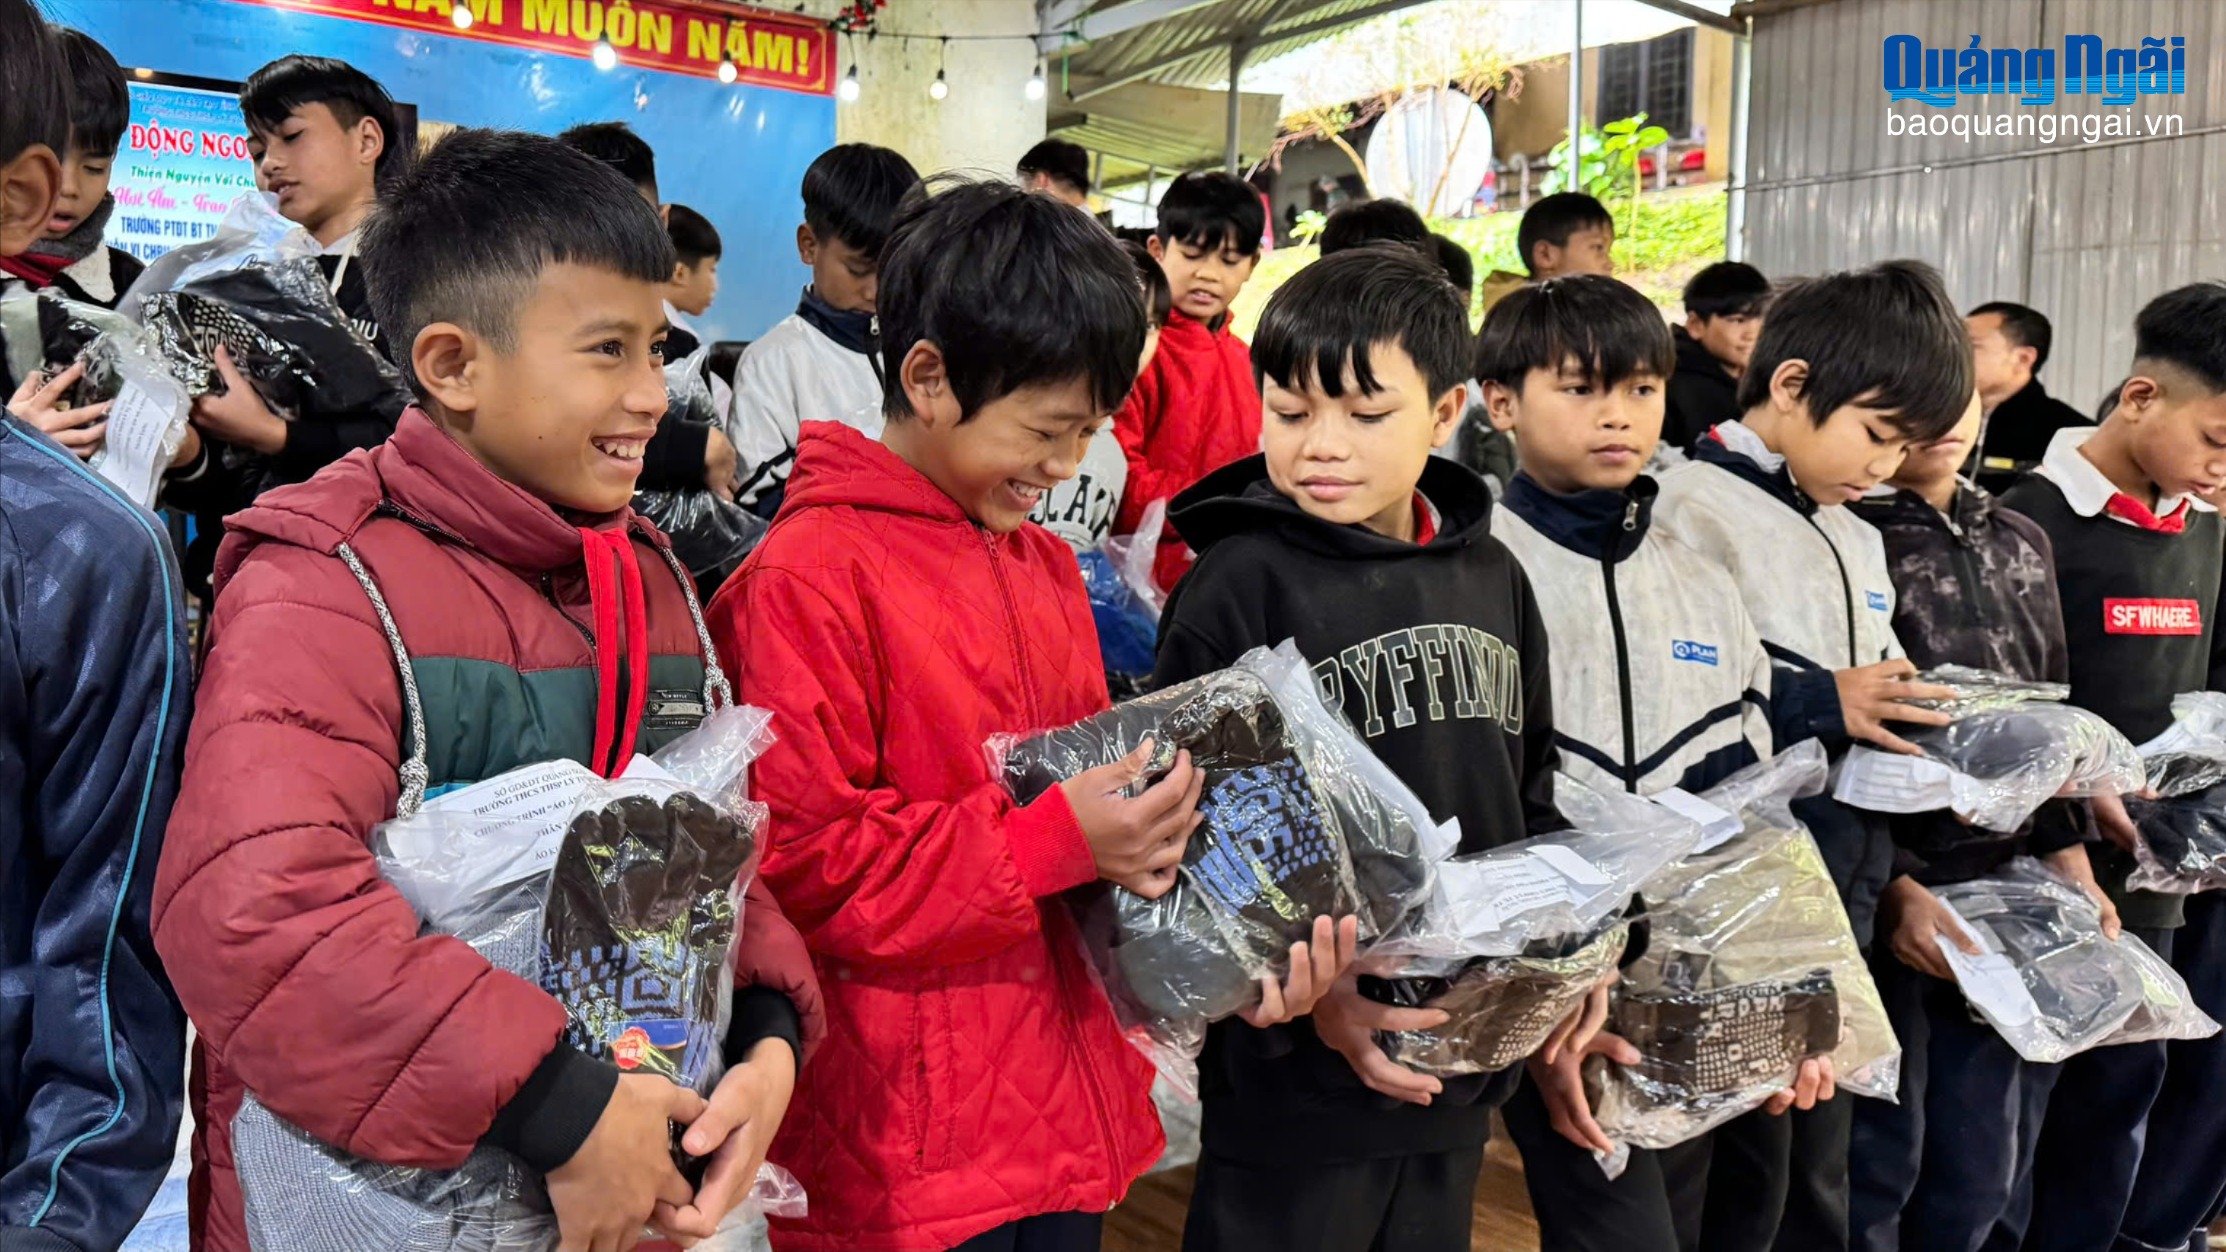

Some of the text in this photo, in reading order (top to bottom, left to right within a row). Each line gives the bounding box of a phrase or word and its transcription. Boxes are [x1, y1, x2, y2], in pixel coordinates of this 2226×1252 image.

[687, 19, 809, 76] NĂM!
[131, 119, 253, 160] ĐỘNG NGO
